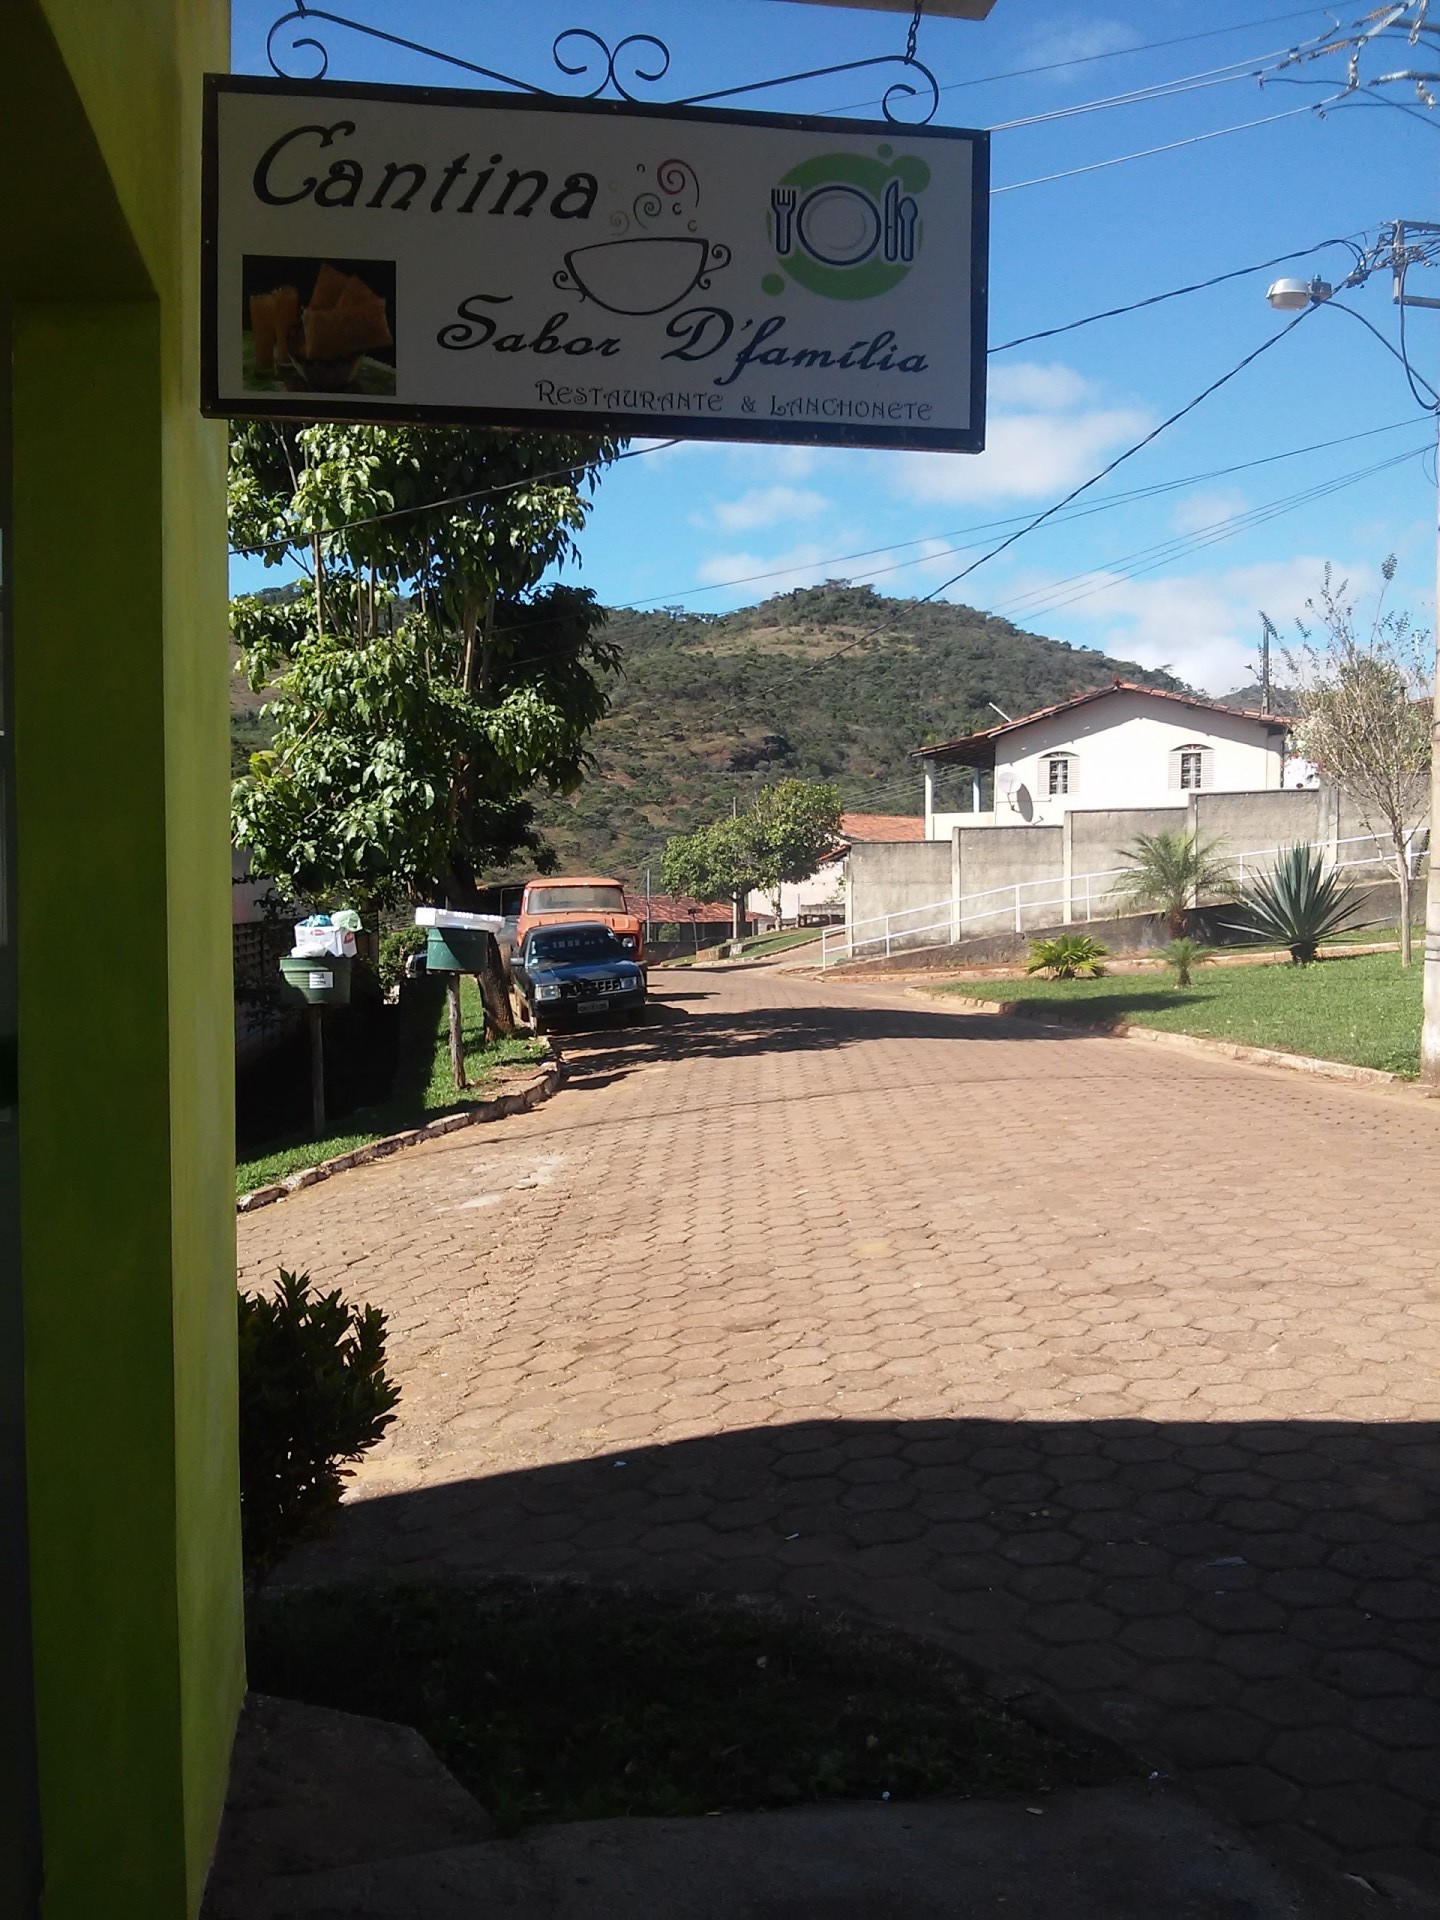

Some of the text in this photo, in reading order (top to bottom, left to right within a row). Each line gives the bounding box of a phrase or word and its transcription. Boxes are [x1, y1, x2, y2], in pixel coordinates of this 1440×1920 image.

[253, 120, 599, 219] Cantina
[436, 294, 929, 386] Sabor D'família
[534, 379, 932, 421] RESTAURANTE & LANCHONETE
